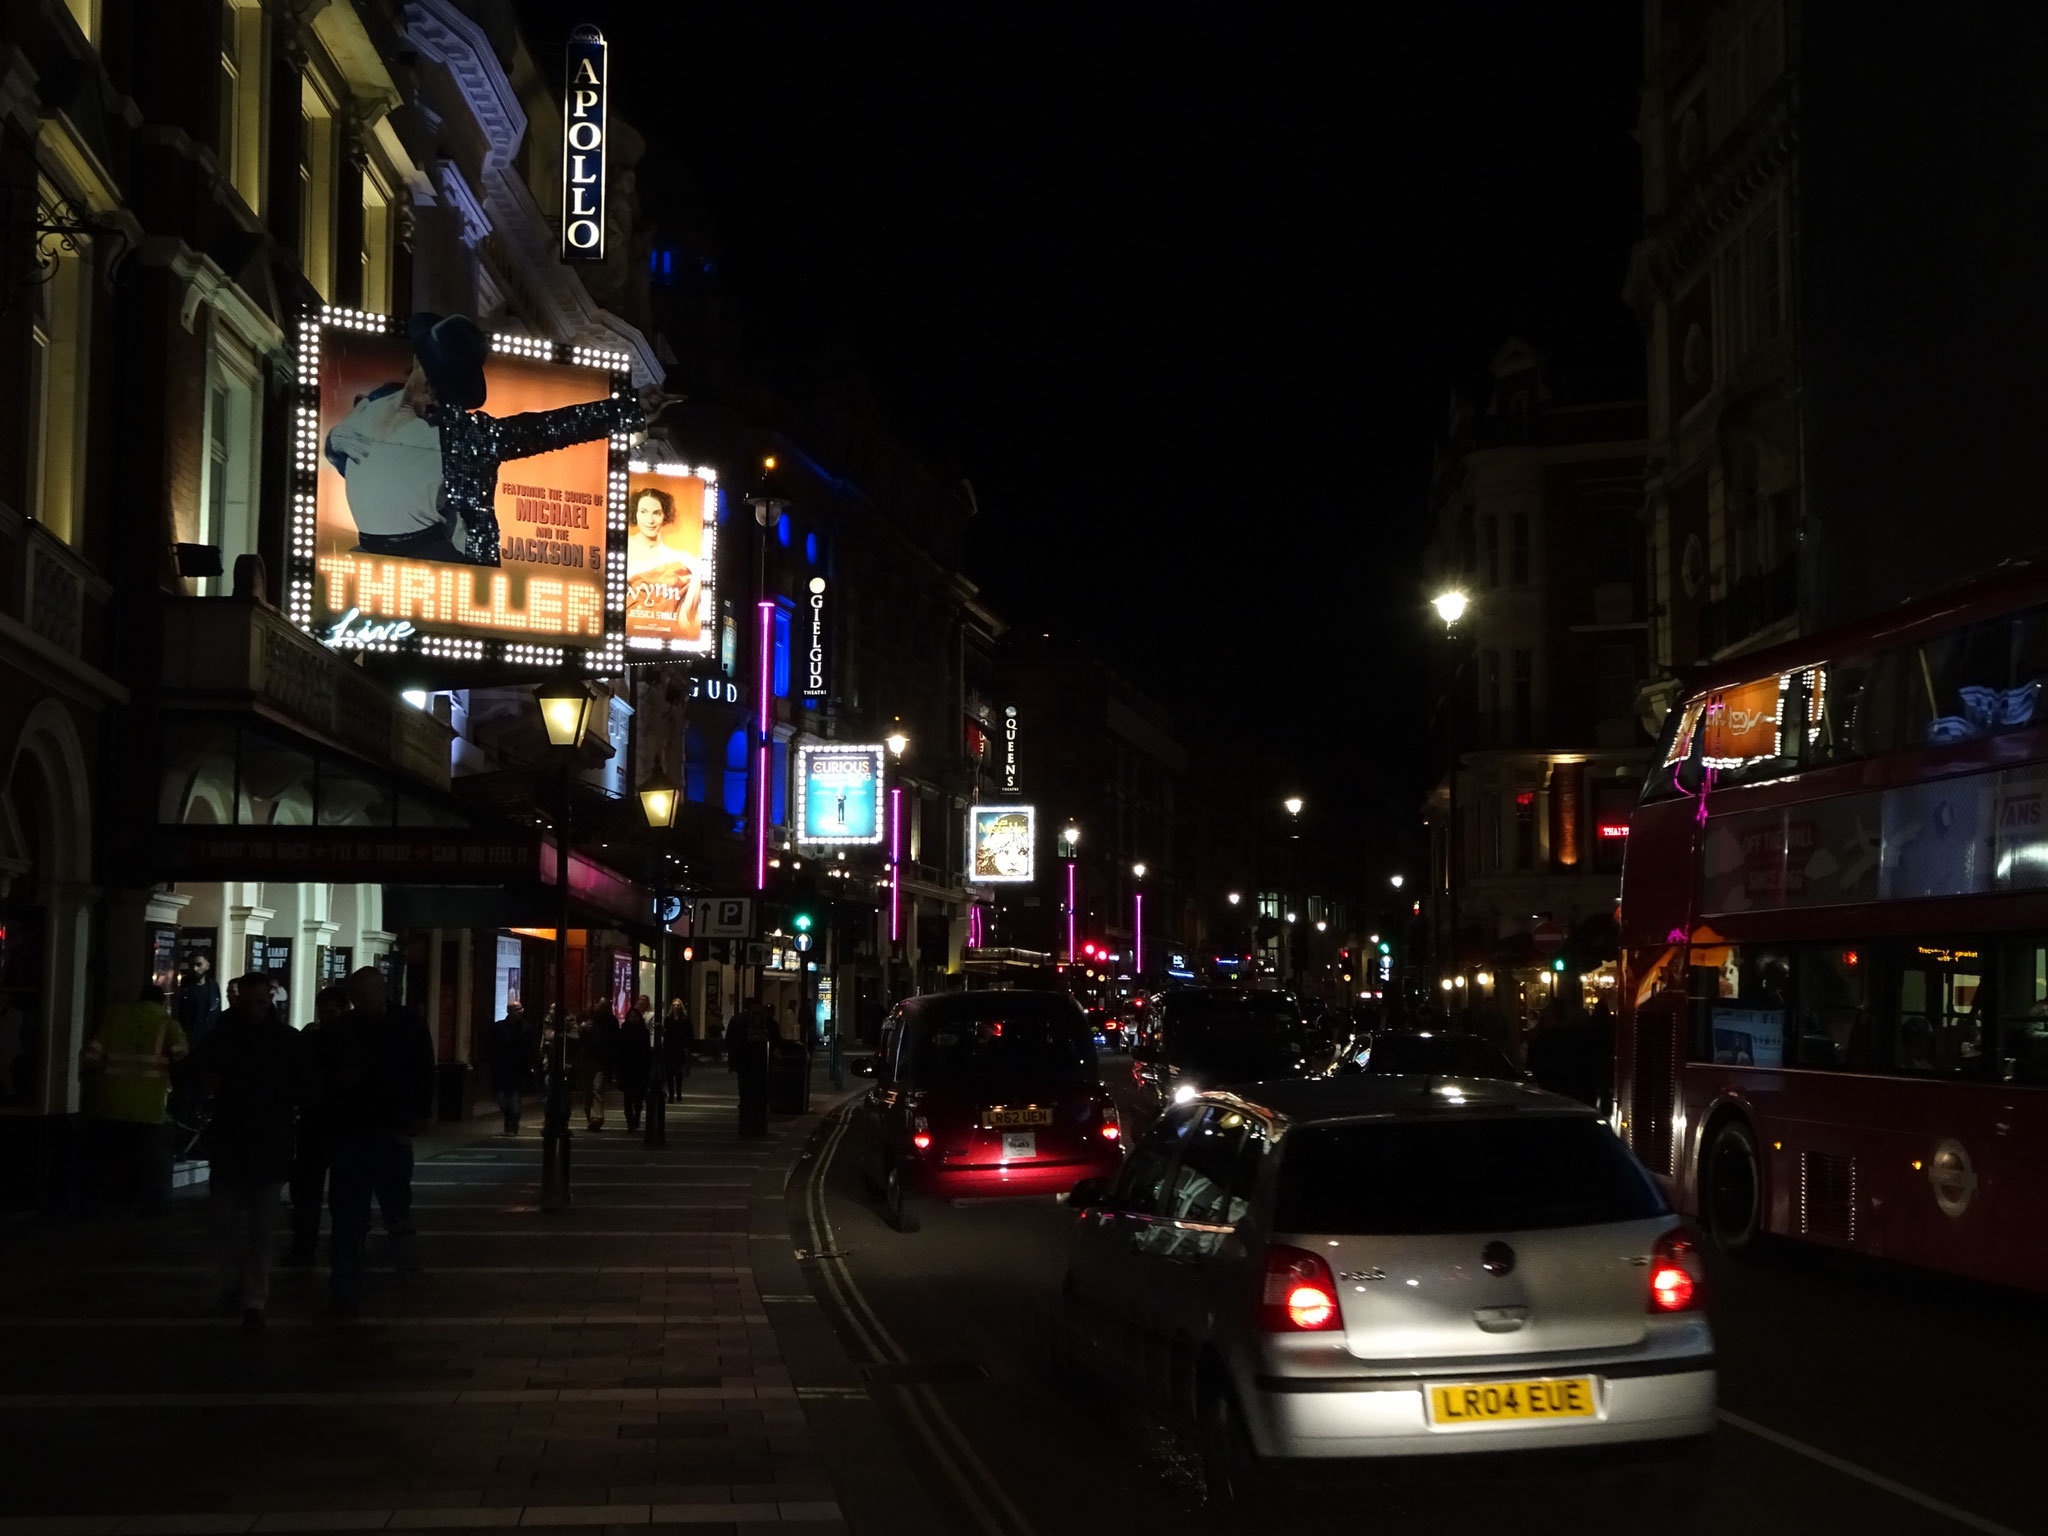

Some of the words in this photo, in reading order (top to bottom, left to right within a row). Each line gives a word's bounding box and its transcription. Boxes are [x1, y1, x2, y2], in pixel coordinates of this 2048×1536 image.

[567, 57, 601, 249] APOLLO
[502, 483, 546, 500] FEATURING
[549, 488, 563, 501] THE
[565, 490, 592, 504] SONGS
[593, 494, 604, 507] OF
[515, 497, 590, 530] MICHAEL
[535, 526, 553, 541] AND
[555, 528, 569, 542] THE
[502, 536, 584, 569] JACKSON
[589, 546, 600, 570] 5
[319, 557, 601, 637] THRILLER
[325, 606, 416, 648] Live
[809, 594, 824, 689] GIELGUD
[813, 760, 870, 774] CURIOUS
[1005, 718, 1018, 787] QUEENS
[1743, 832, 1762, 853] OFF
[724, 903, 740, 924] P
[987, 1111, 1020, 1125] LR62
[1022, 1110, 1048, 1123] UEN
[1442, 1385, 1521, 1418] LR04
[1527, 1379, 1584, 1413] EUE
